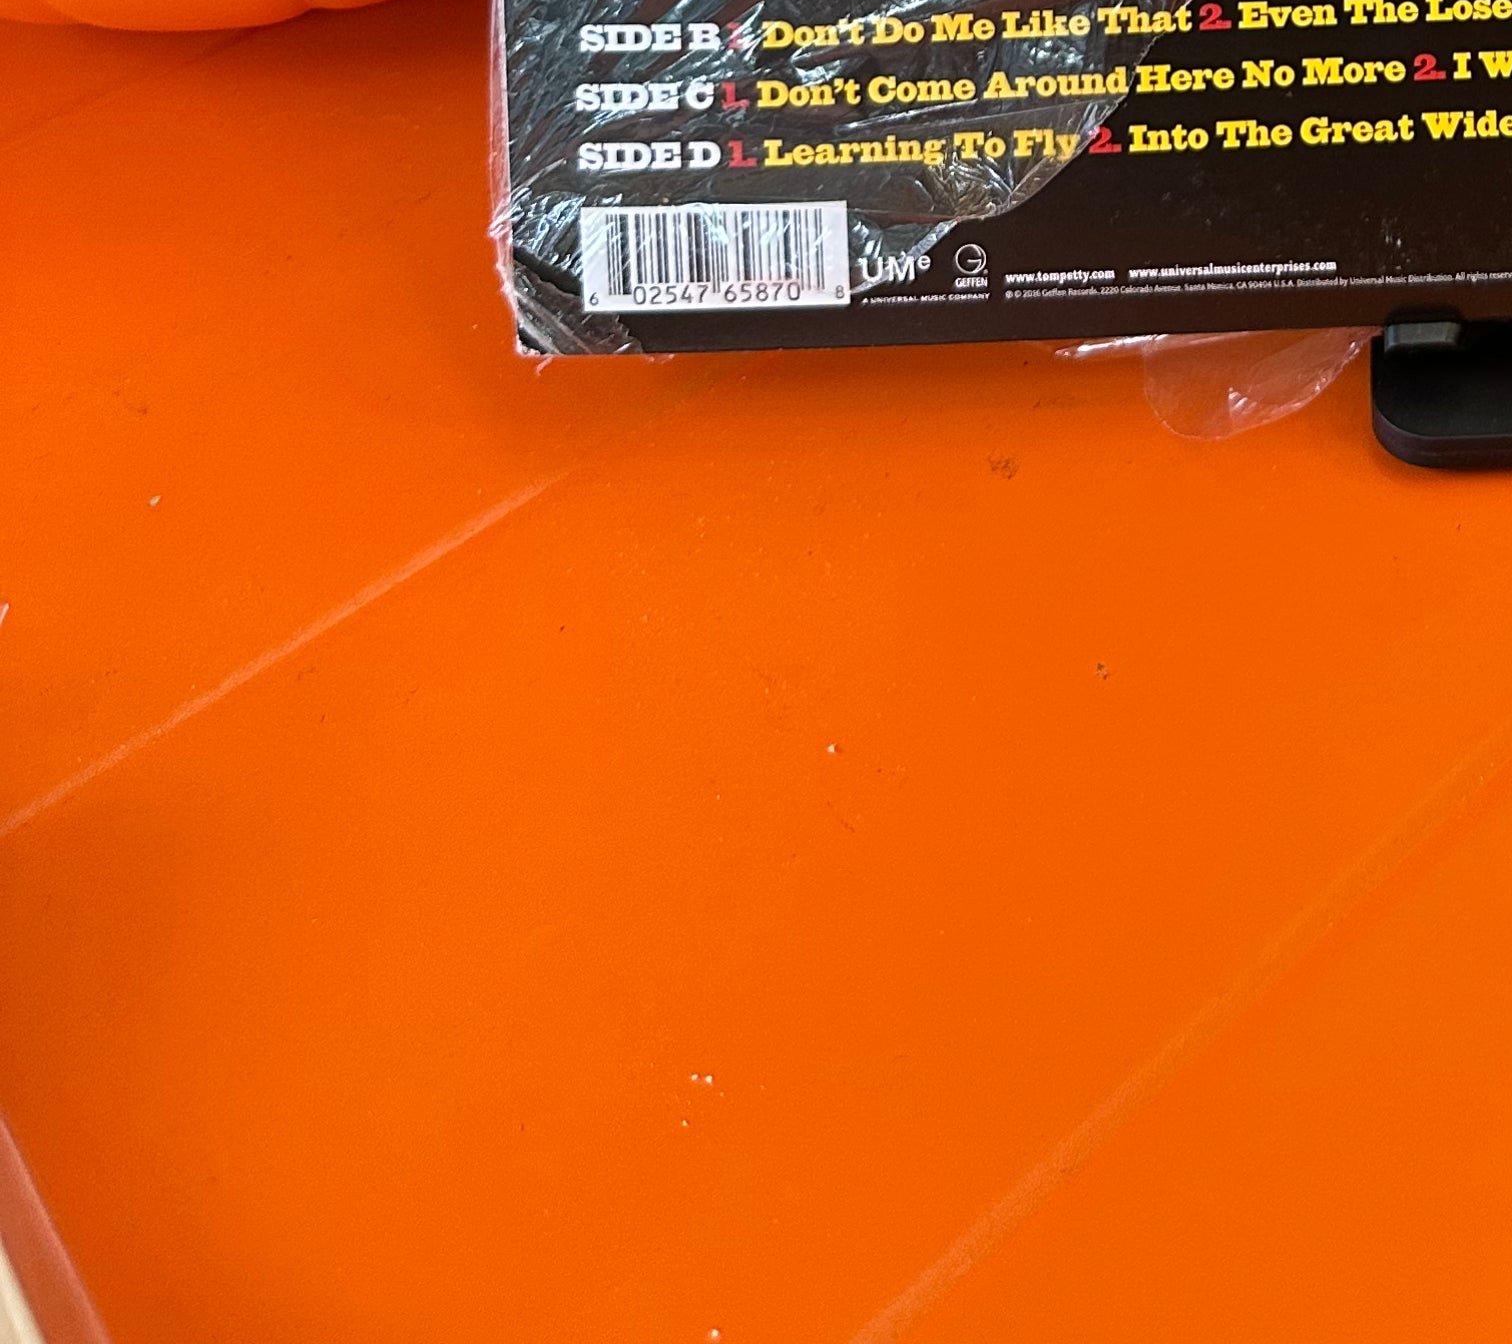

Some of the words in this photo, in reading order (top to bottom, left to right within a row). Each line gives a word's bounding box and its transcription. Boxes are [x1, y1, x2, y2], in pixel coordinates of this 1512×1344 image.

[578, 22, 682, 53] SIDE
[688, 22, 721, 51] B
[762, 18, 866, 50] Don't
[873, 15, 926, 46] Do
[931, 13, 995, 43] Me
[1001, 8, 1091, 40] Like
[1098, 5, 1193, 36] That
[1199, 3, 1232, 31] 2.
[1238, 0, 1338, 31] Even
[576, 81, 682, 112] SIDE
[686, 80, 715, 111] C
[756, 76, 862, 109] Don't
[868, 73, 977, 106] Come
[983, 65, 1129, 101] Around
[1135, 63, 1235, 94] Here
[1241, 59, 1296, 90] No
[1302, 55, 1407, 87] More
[1413, 53, 1447, 82] 2.
[1453, 51, 1472, 80] I
[578, 140, 682, 171] SIDE
[687, 140, 722, 169] D
[762, 133, 944, 170] Learning
[952, 130, 1006, 161] To
[1012, 126, 1082, 163] Fly
[1088, 125, 1122, 156] 2.
[1128, 122, 1209, 155] Into
[1216, 118, 1293, 150] The
[1300, 114, 1415, 147] Great
[955, 276, 988, 289] GEFFEN
[1004, 268, 1116, 285] www.tompetty.com
[1128, 259, 1337, 278] www.universalmusicenterprises.com
[588, 292, 600, 308] 6
[633, 284, 710, 306] 02547
[723, 281, 801, 304] 65870
[835, 284, 846, 300] 8
